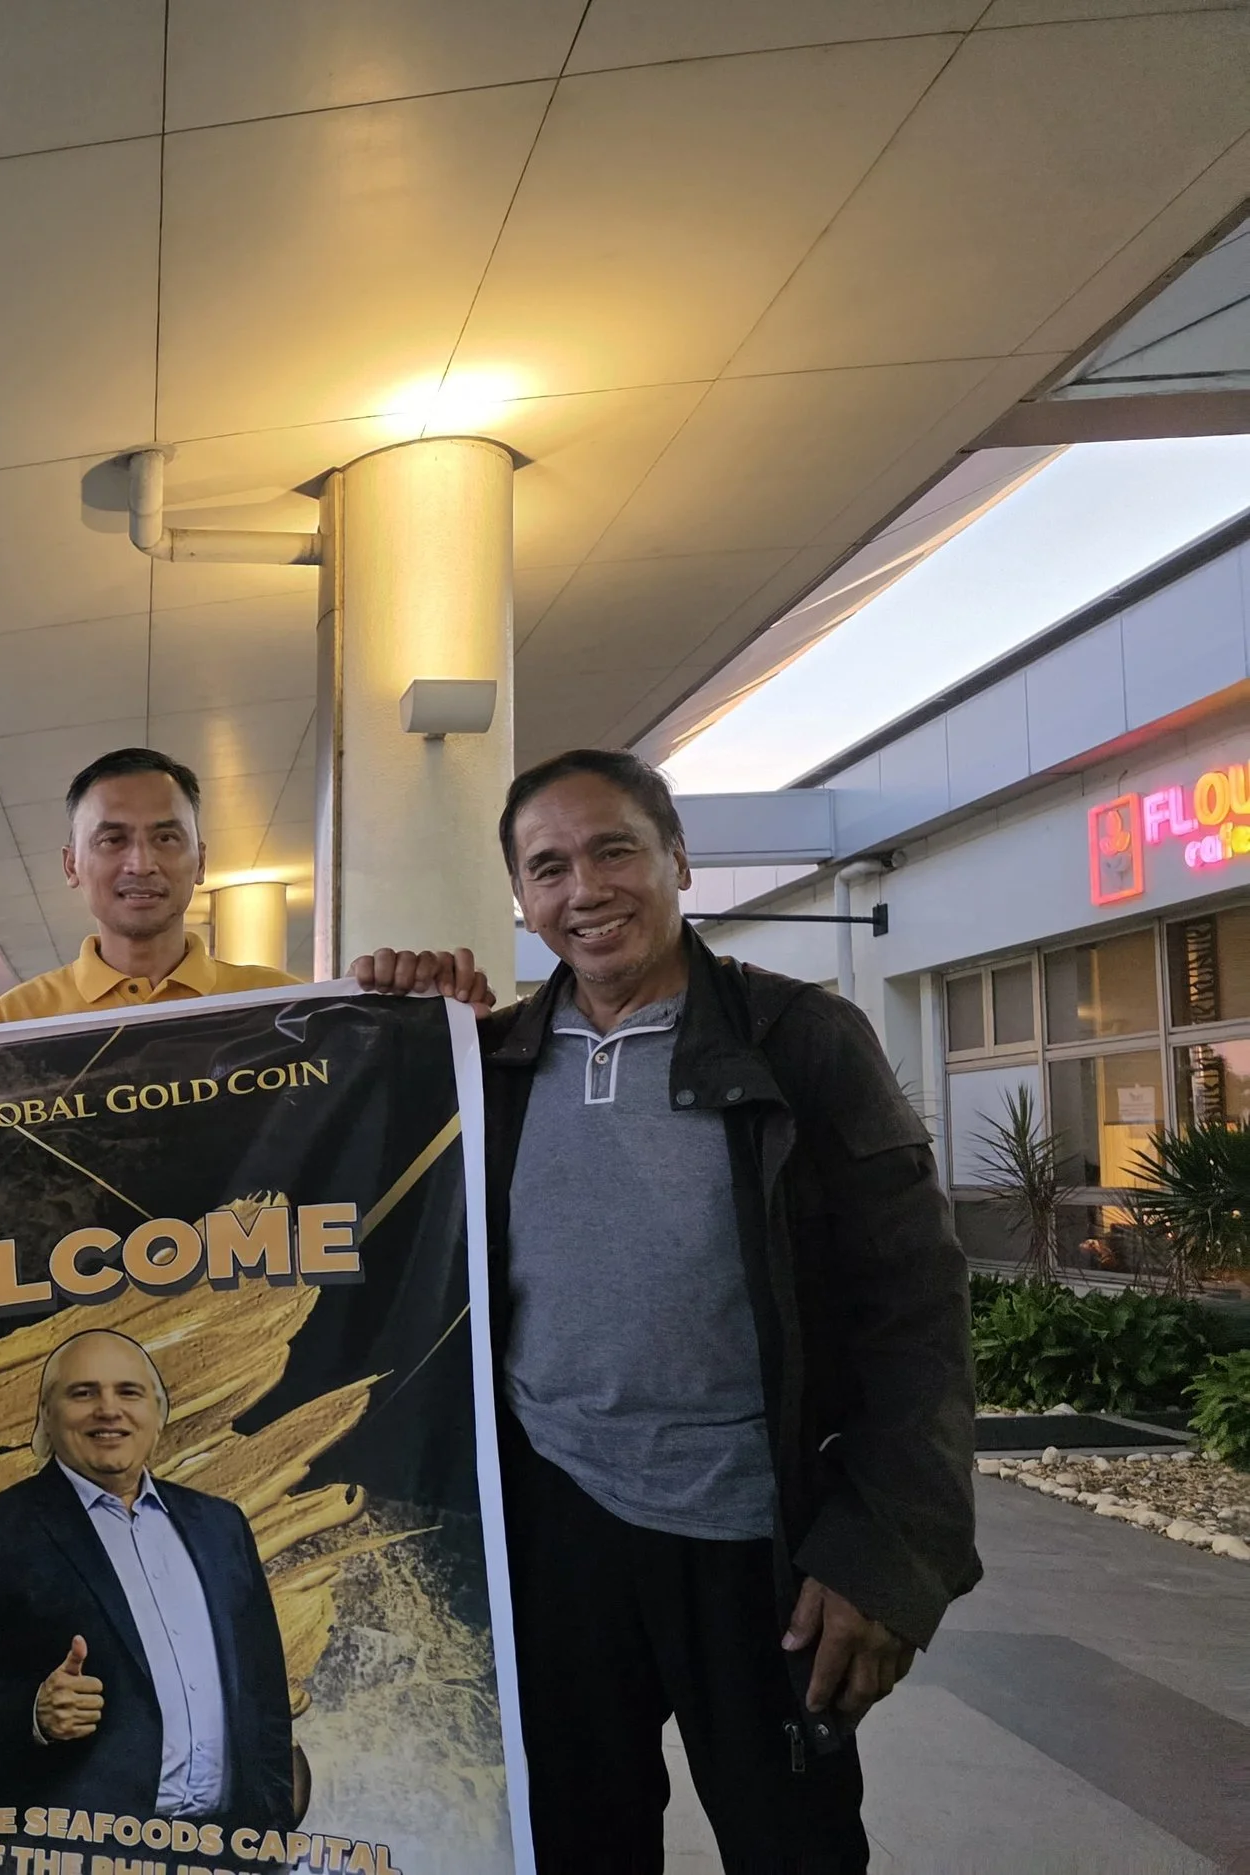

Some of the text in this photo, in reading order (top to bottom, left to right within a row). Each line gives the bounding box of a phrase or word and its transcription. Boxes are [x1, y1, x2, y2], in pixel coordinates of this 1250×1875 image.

[106, 1078, 219, 1114] GOLD
[227, 1059, 330, 1094] COIN
[10, 1845, 84, 1875] THE
[23, 1806, 224, 1856] SEAFOODS
[230, 1826, 403, 1875] CAPITAL
